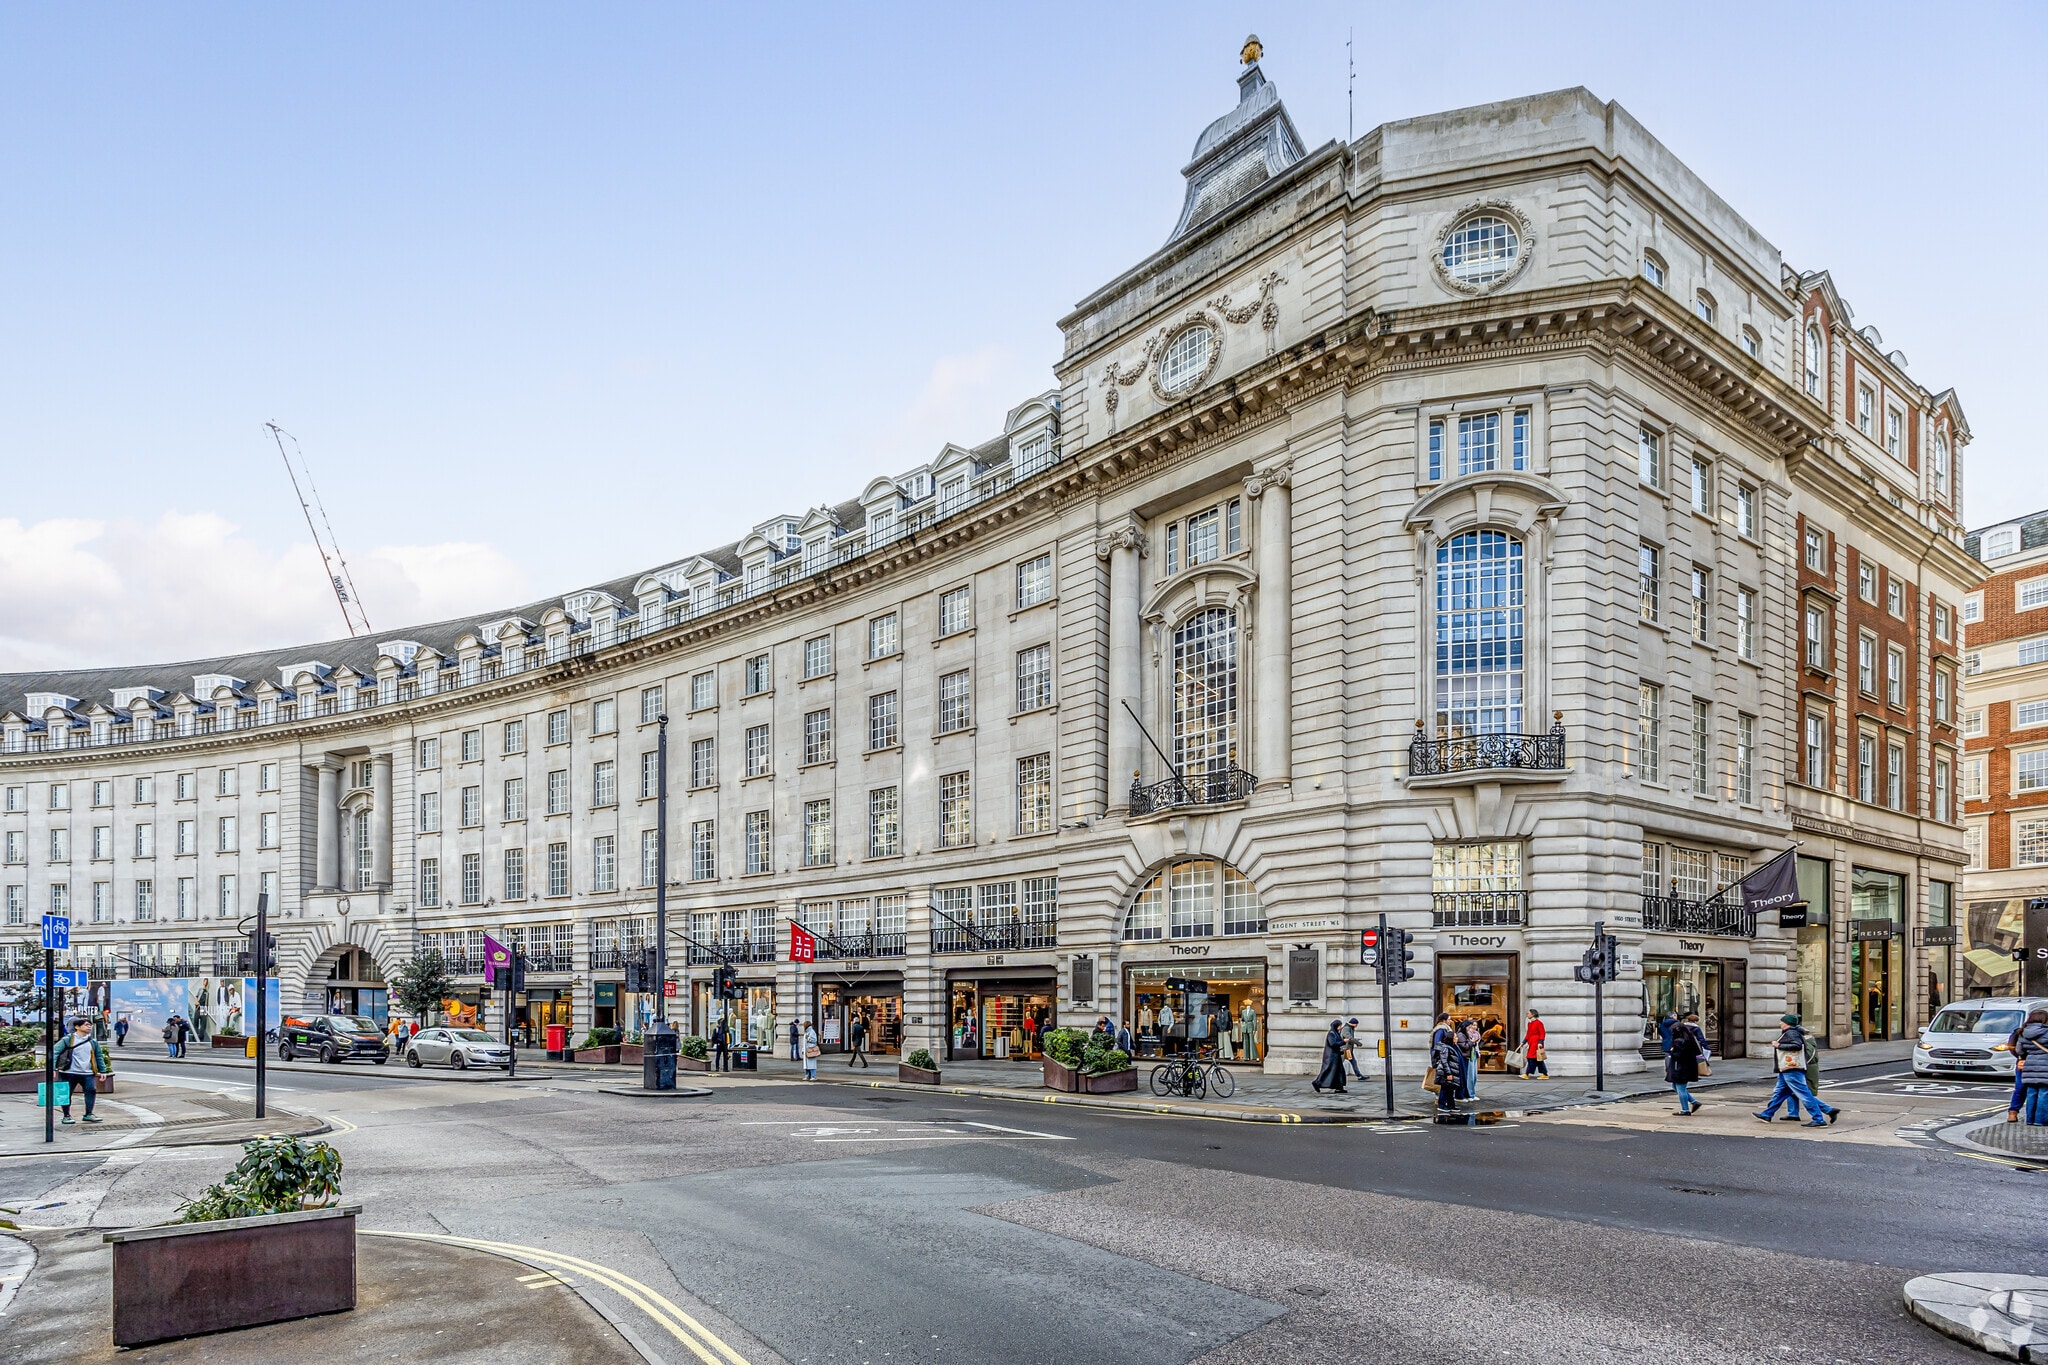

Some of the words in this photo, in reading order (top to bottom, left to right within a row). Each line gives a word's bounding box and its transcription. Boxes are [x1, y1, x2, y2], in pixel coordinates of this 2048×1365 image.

[1751, 892, 1794, 908] Theory
[1302, 920, 1326, 928] STREET
[1449, 934, 1506, 948] Theory
[1679, 940, 1704, 953] Theory
[1169, 945, 1210, 955] Theory
